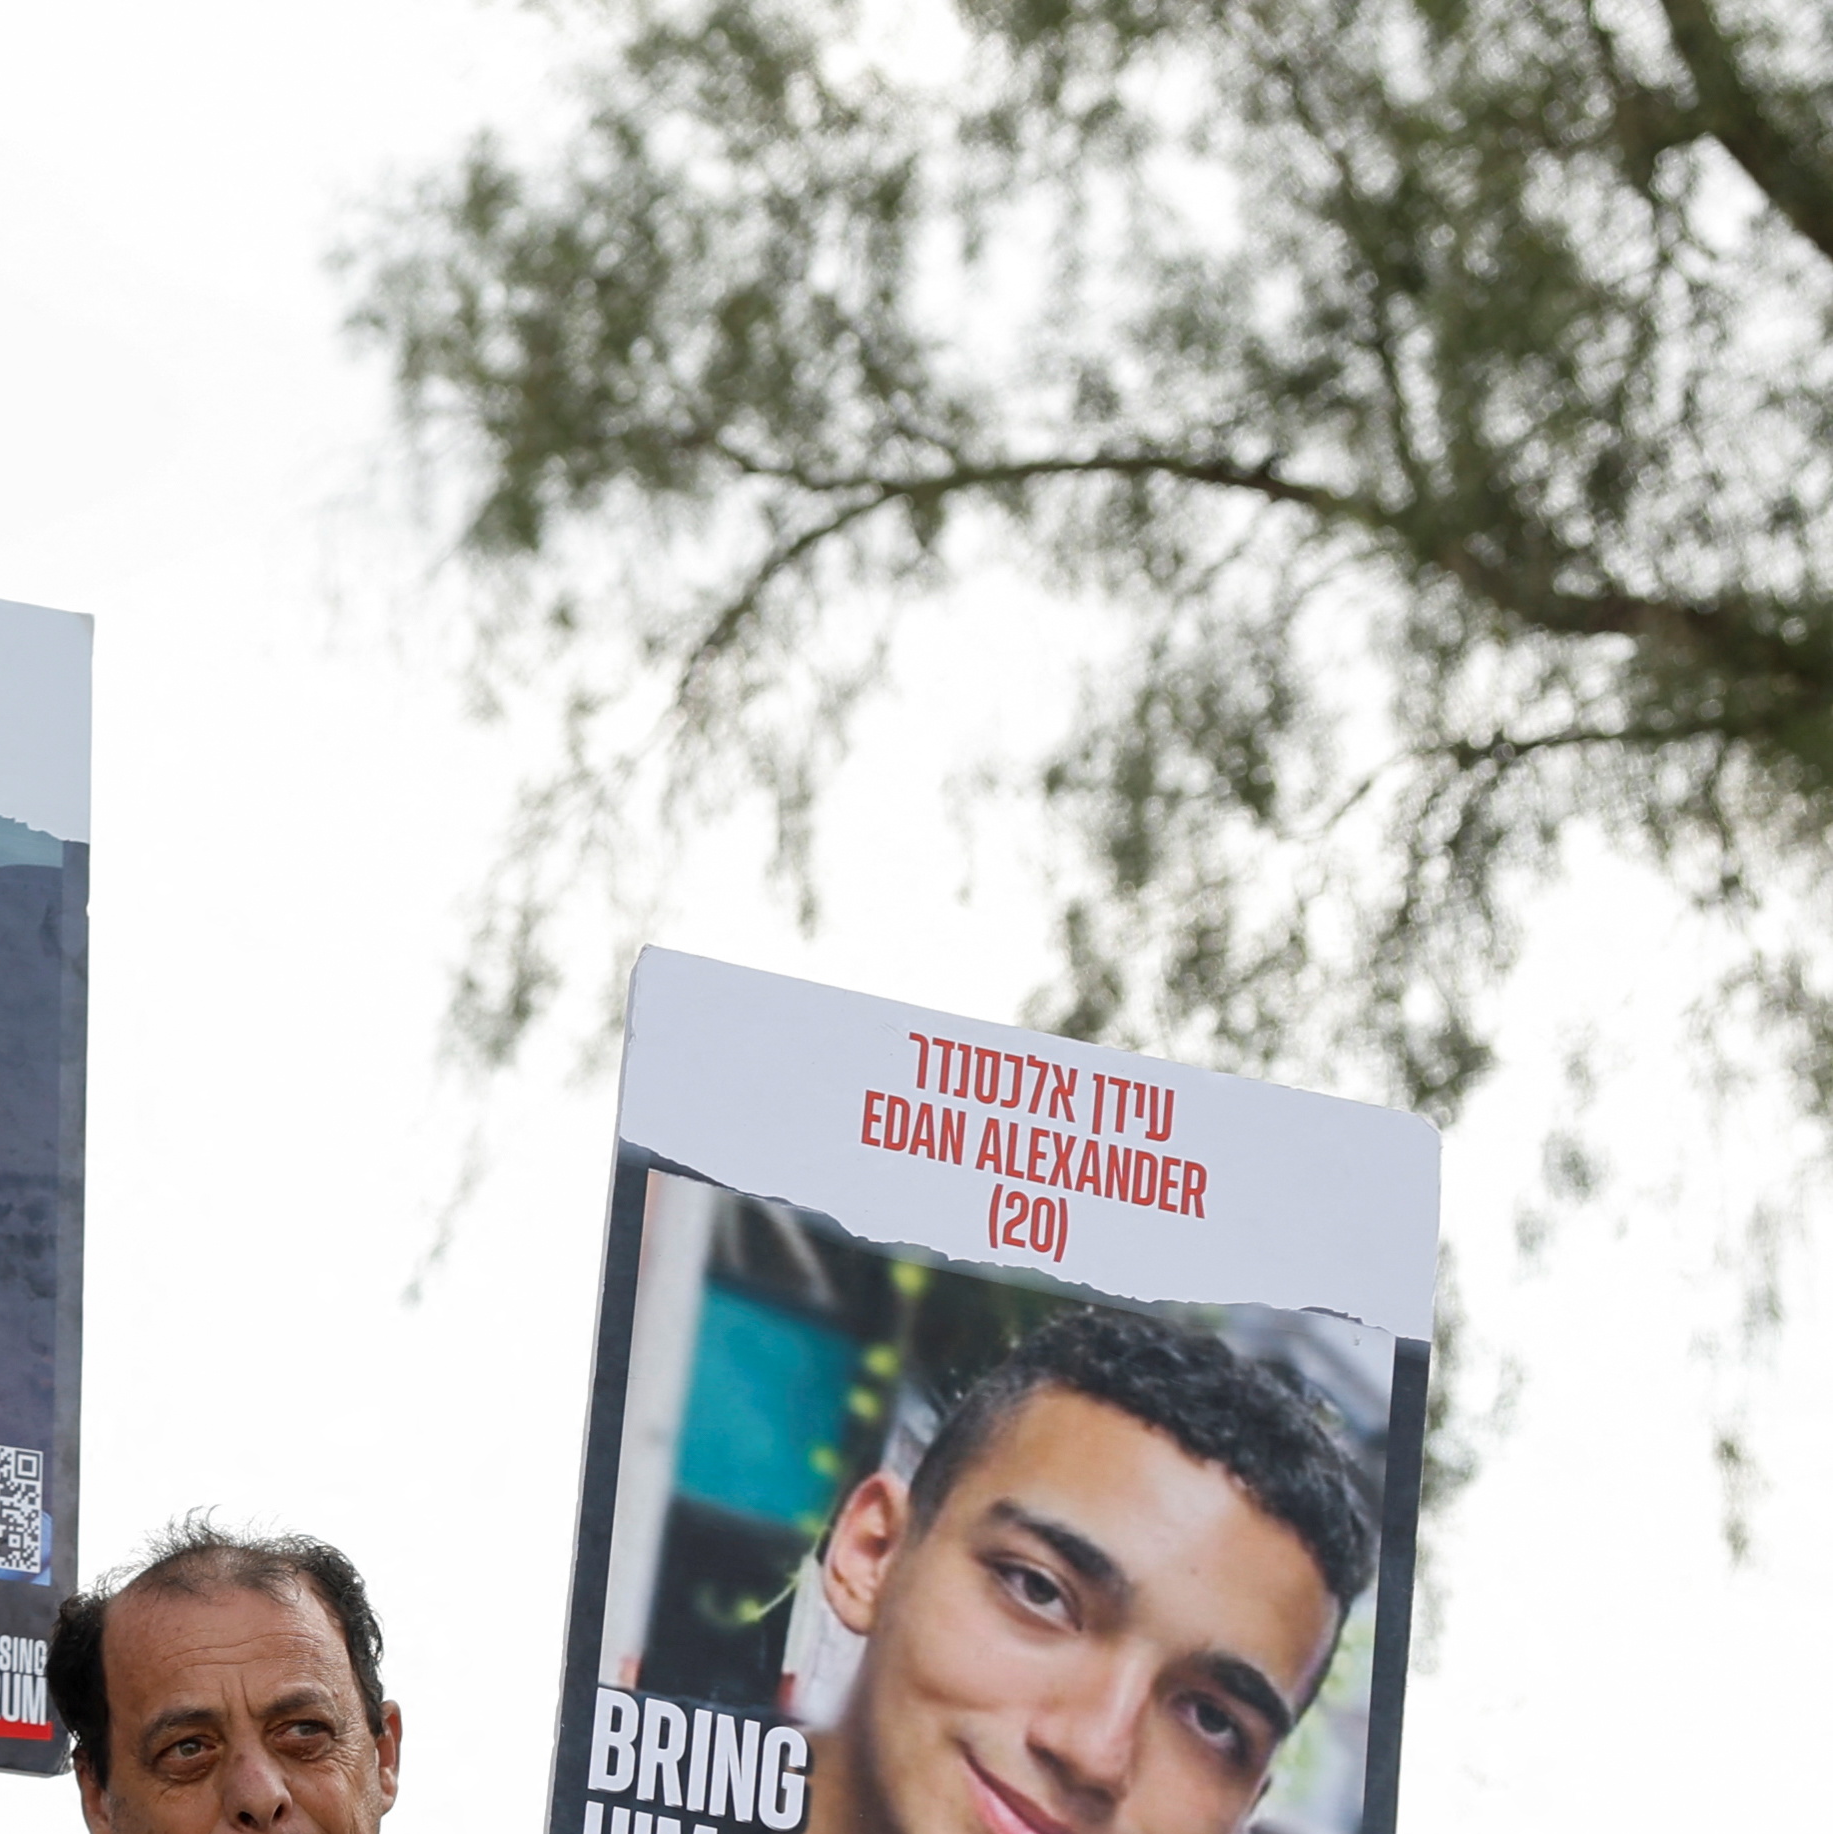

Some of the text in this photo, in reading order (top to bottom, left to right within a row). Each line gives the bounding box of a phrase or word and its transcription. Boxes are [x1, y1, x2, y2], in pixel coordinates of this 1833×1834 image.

[909, 1031, 1176, 1142] עידן אלכסנדר
[861, 1088, 1208, 1219] EDAN ALEXANDER
[987, 1183, 1070, 1264] (20)
[587, 1687, 810, 1833] BRING
